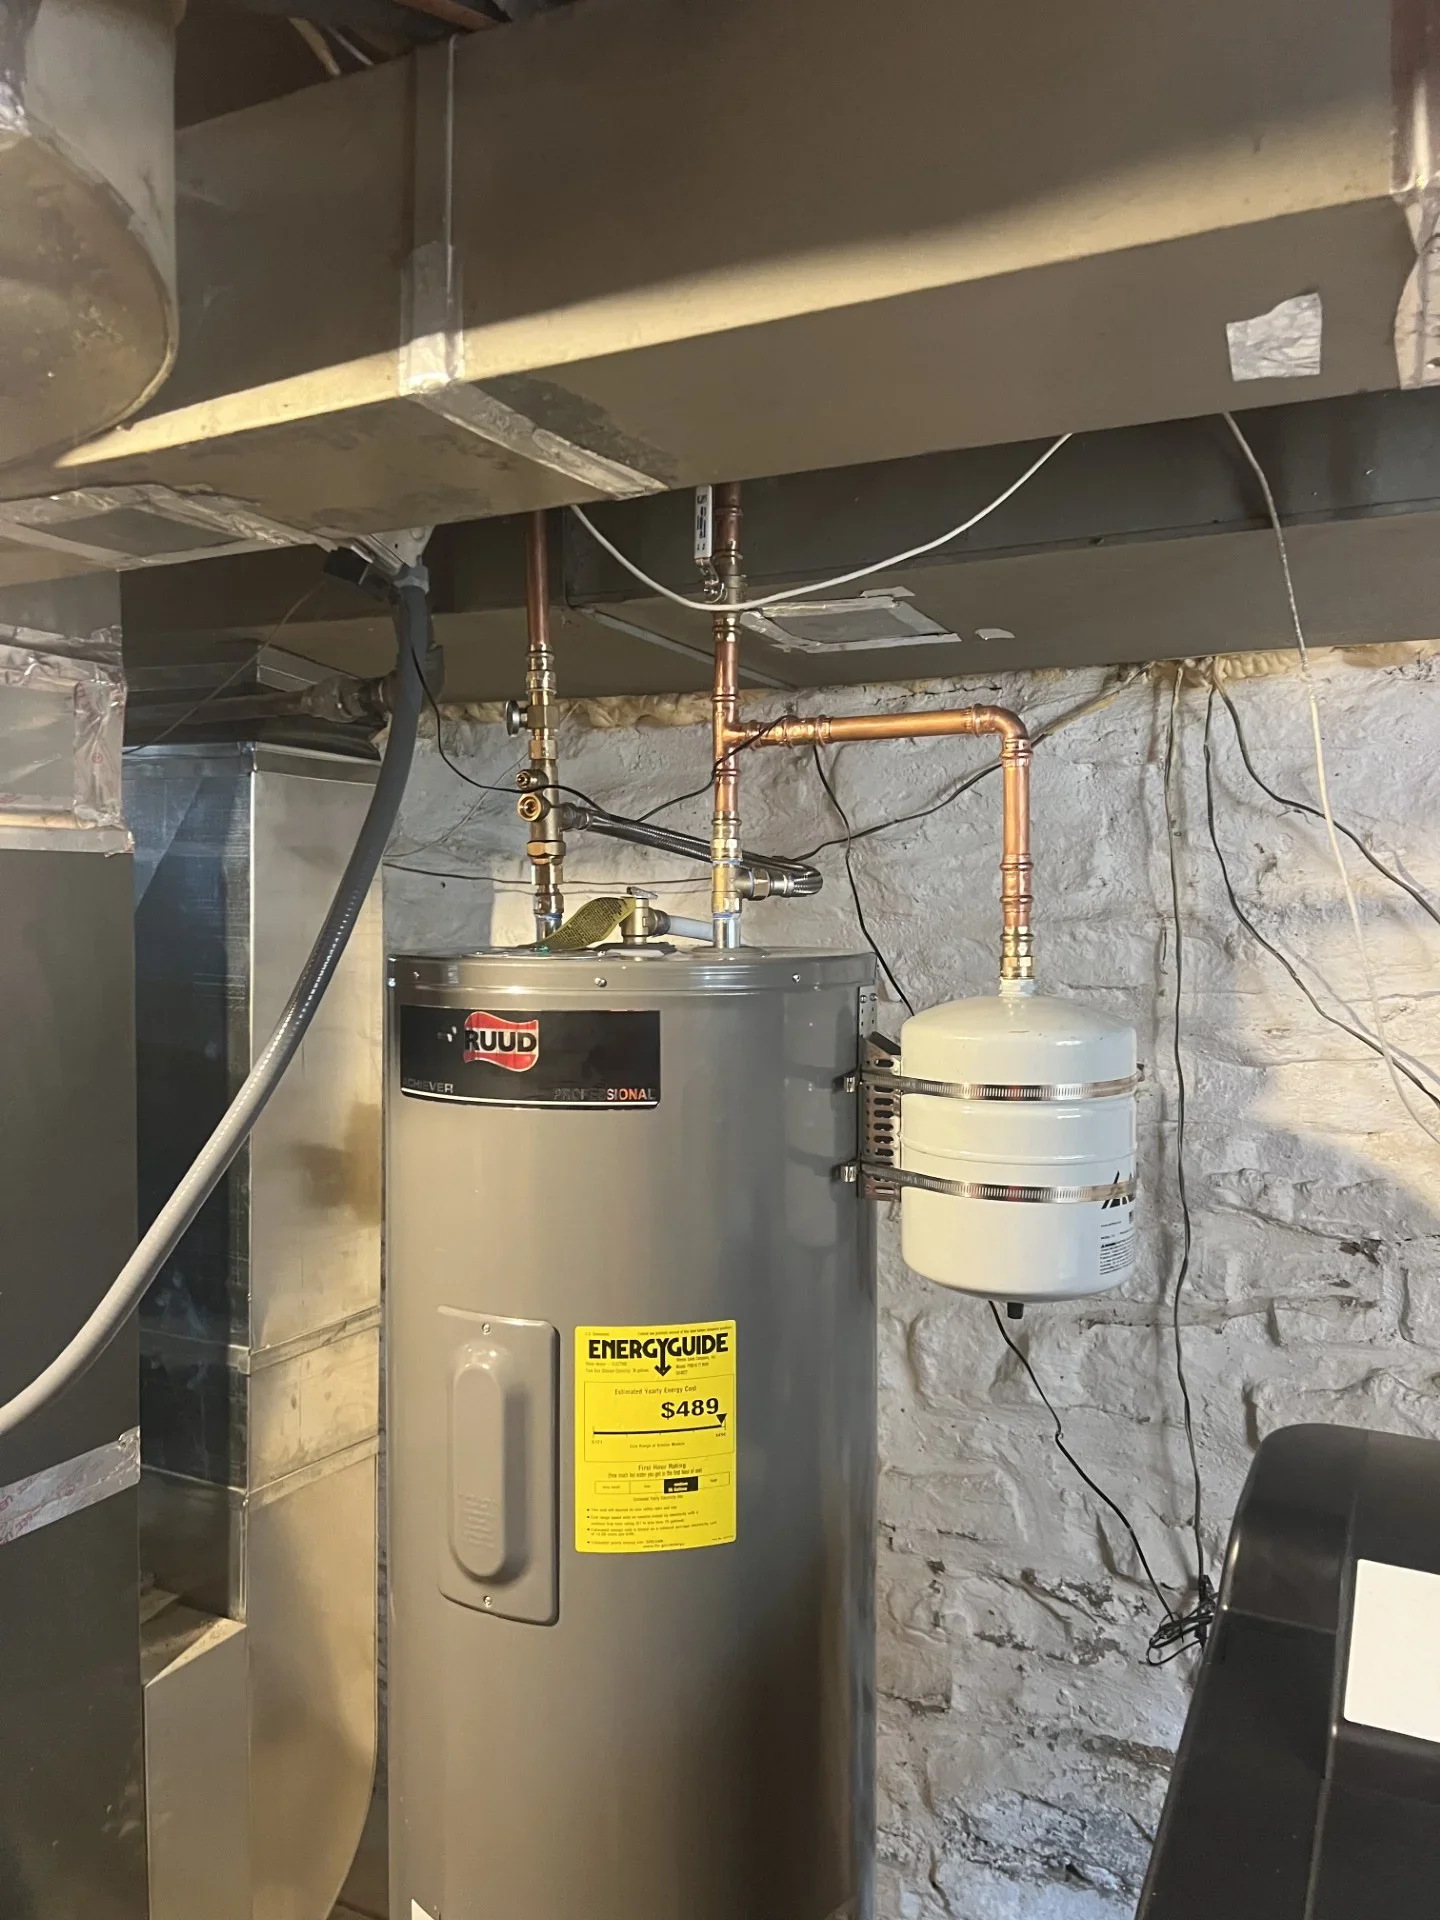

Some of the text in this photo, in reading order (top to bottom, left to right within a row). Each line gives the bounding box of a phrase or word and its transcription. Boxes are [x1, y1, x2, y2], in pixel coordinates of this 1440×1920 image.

[464, 1029, 537, 1053] RUUD
[588, 1332, 729, 1360] ENERGYGUIDE
[645, 1387, 662, 1395] Yearly
[664, 1386, 683, 1394] Energy
[661, 1397, 719, 1420] $489
